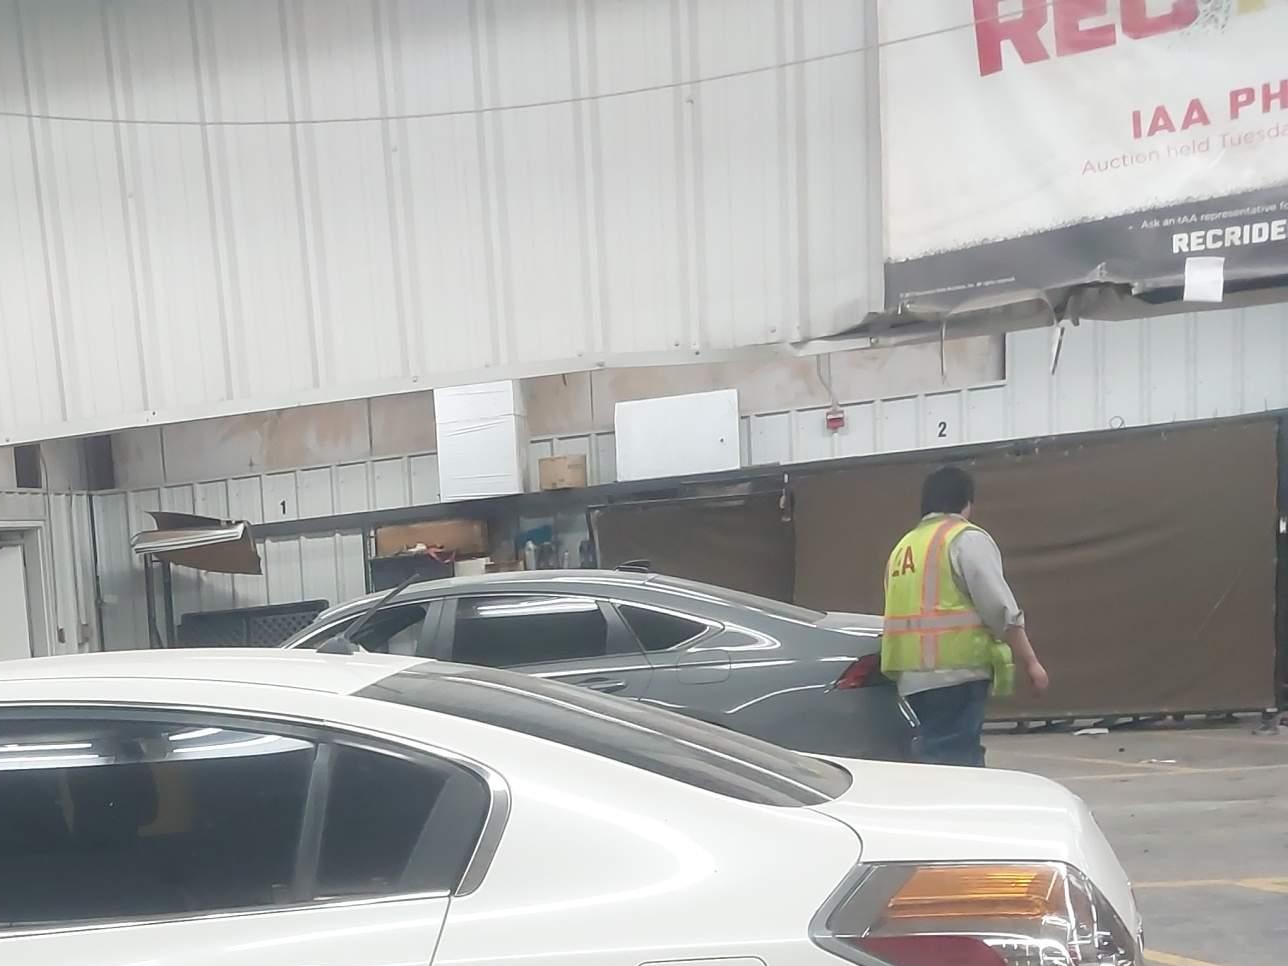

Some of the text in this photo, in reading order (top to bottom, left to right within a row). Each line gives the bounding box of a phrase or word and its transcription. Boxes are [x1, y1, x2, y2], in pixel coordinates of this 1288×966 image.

[1132, 79, 1288, 139] IAA PH
[1081, 150, 1160, 176] Auction
[1167, 136, 1210, 159] held
[1141, 218, 1160, 229] Ask
[1163, 217, 1175, 227] an
[1200, 202, 1277, 222] representative
[1172, 219, 1287, 254] RECRIDE
[938, 421, 947, 438] 2
[280, 500, 286, 515] 1
